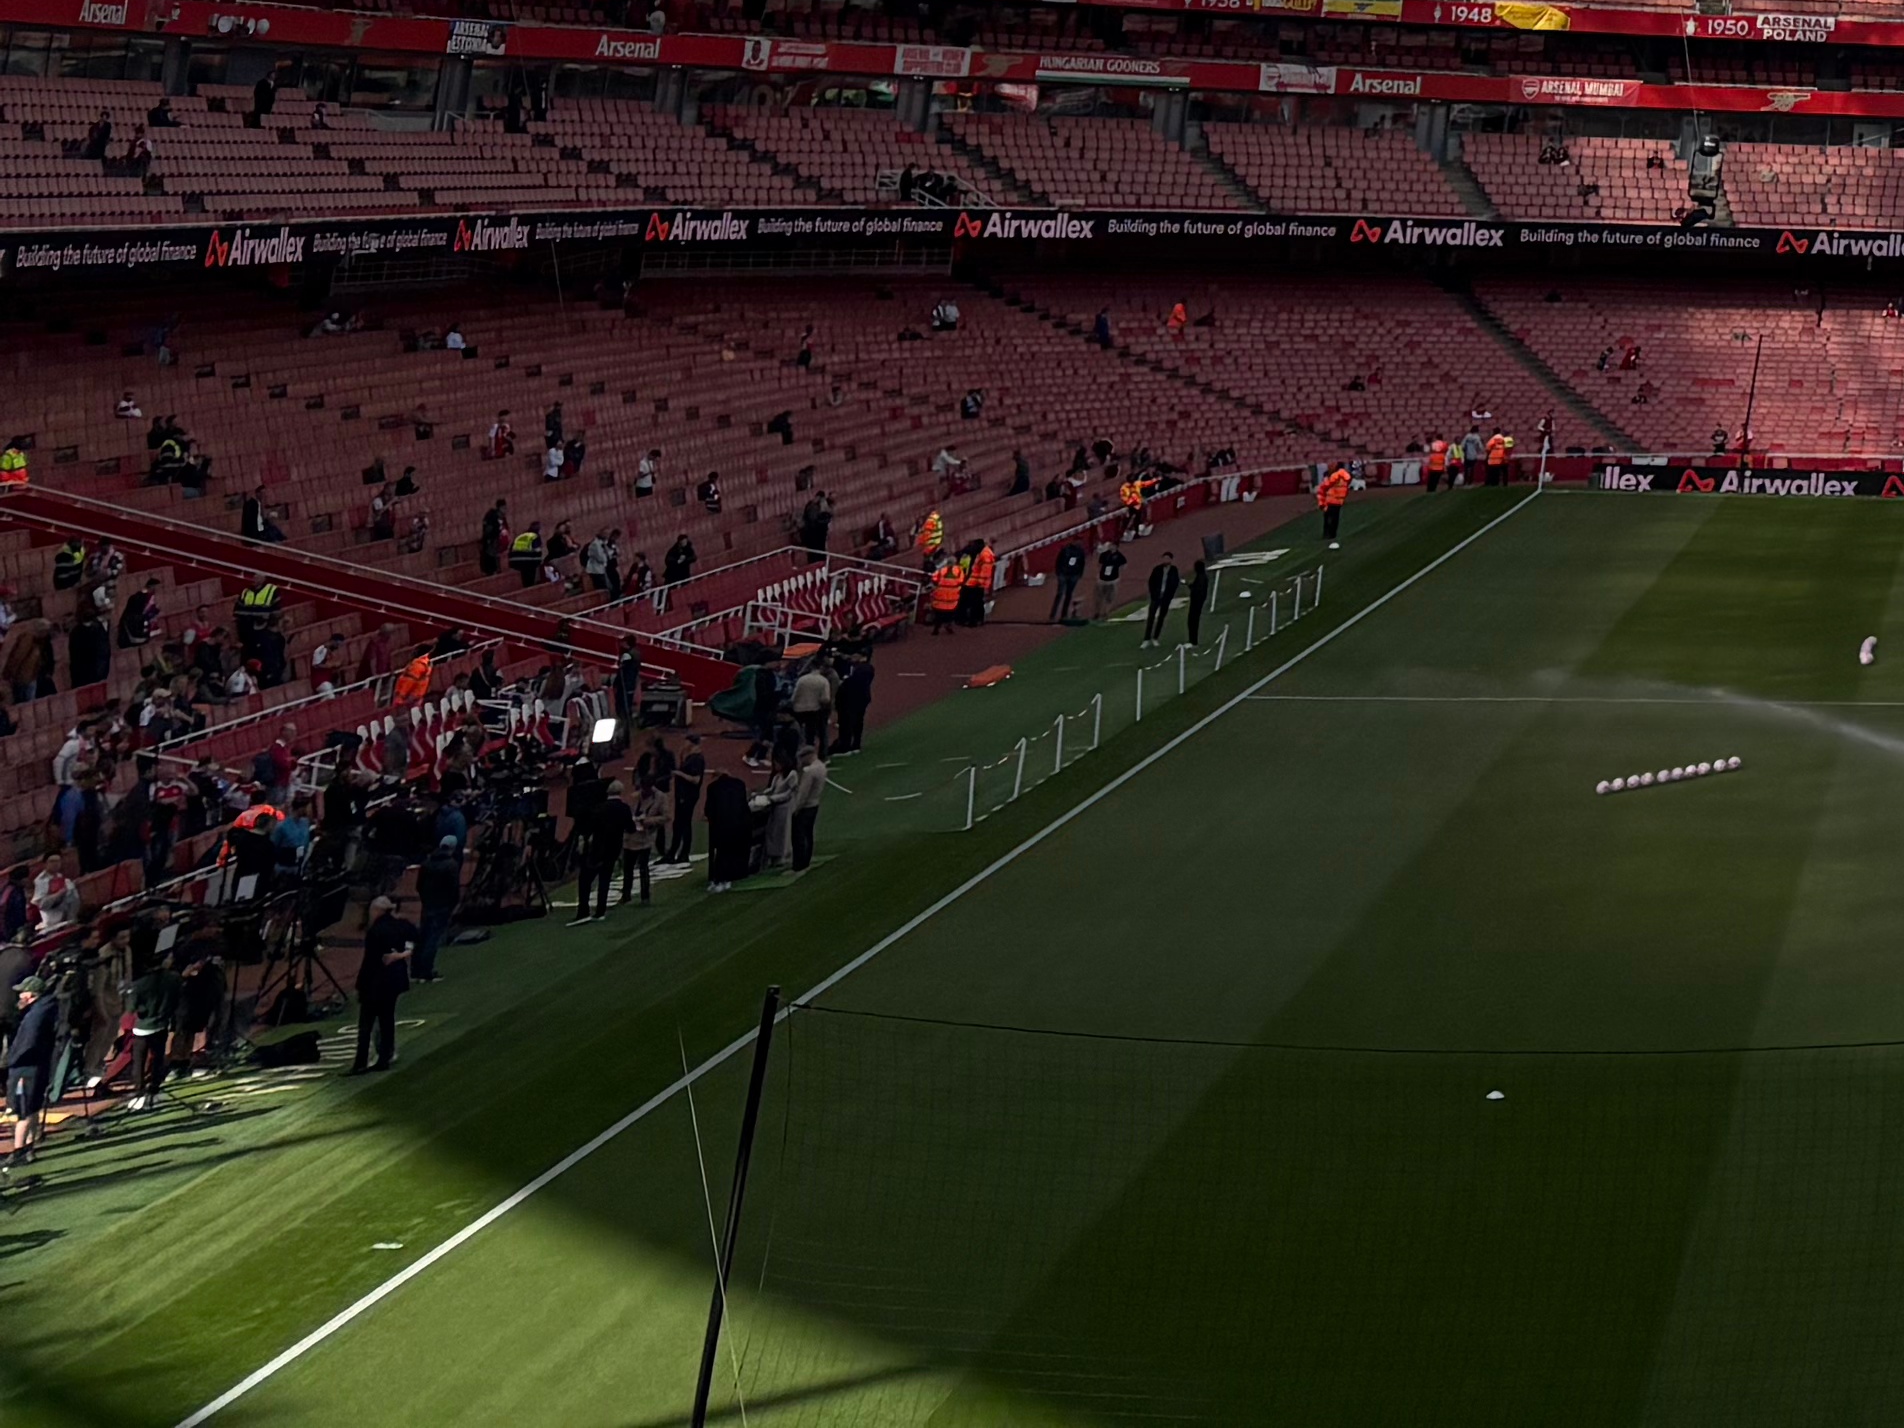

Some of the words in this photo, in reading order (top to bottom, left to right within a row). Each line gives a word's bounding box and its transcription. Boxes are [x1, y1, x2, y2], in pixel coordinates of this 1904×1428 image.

[1451, 6, 1491, 23] 1948
[1761, 15, 1833, 30] ARSENAL
[1707, 19, 1748, 35] 1950
[1762, 28, 1827, 43] POLAND
[595, 34, 661, 58] Arsenal
[1040, 55, 1104, 72] HUNGARIAN
[1106, 59, 1160, 74] GOONERS
[1350, 74, 1421, 95] Arsenal
[1541, 81, 1581, 94] ARSENAL
[1584, 82, 1623, 96] MUMBAI
[471, 218, 530, 251] Airwallex
[669, 212, 749, 244] Airwallex
[983, 211, 1095, 239] Airwallex
[1108, 218, 1157, 236] Building
[1159, 219, 1180, 234] the
[1182, 219, 1225, 235] future
[1227, 220, 1242, 235] of
[1245, 221, 1285, 239] global
[1288, 222, 1336, 237] finance
[1383, 220, 1504, 247] Airwallex
[228, 227, 305, 267] Airwallex
[1520, 228, 1574, 246] Building
[1577, 230, 1599, 243] the
[1602, 231, 1642, 244] future
[1646, 233, 1661, 246] of
[1664, 232, 1707, 250] global
[1709, 233, 1760, 248] finance
[1720, 470, 1859, 496] Airwallex
